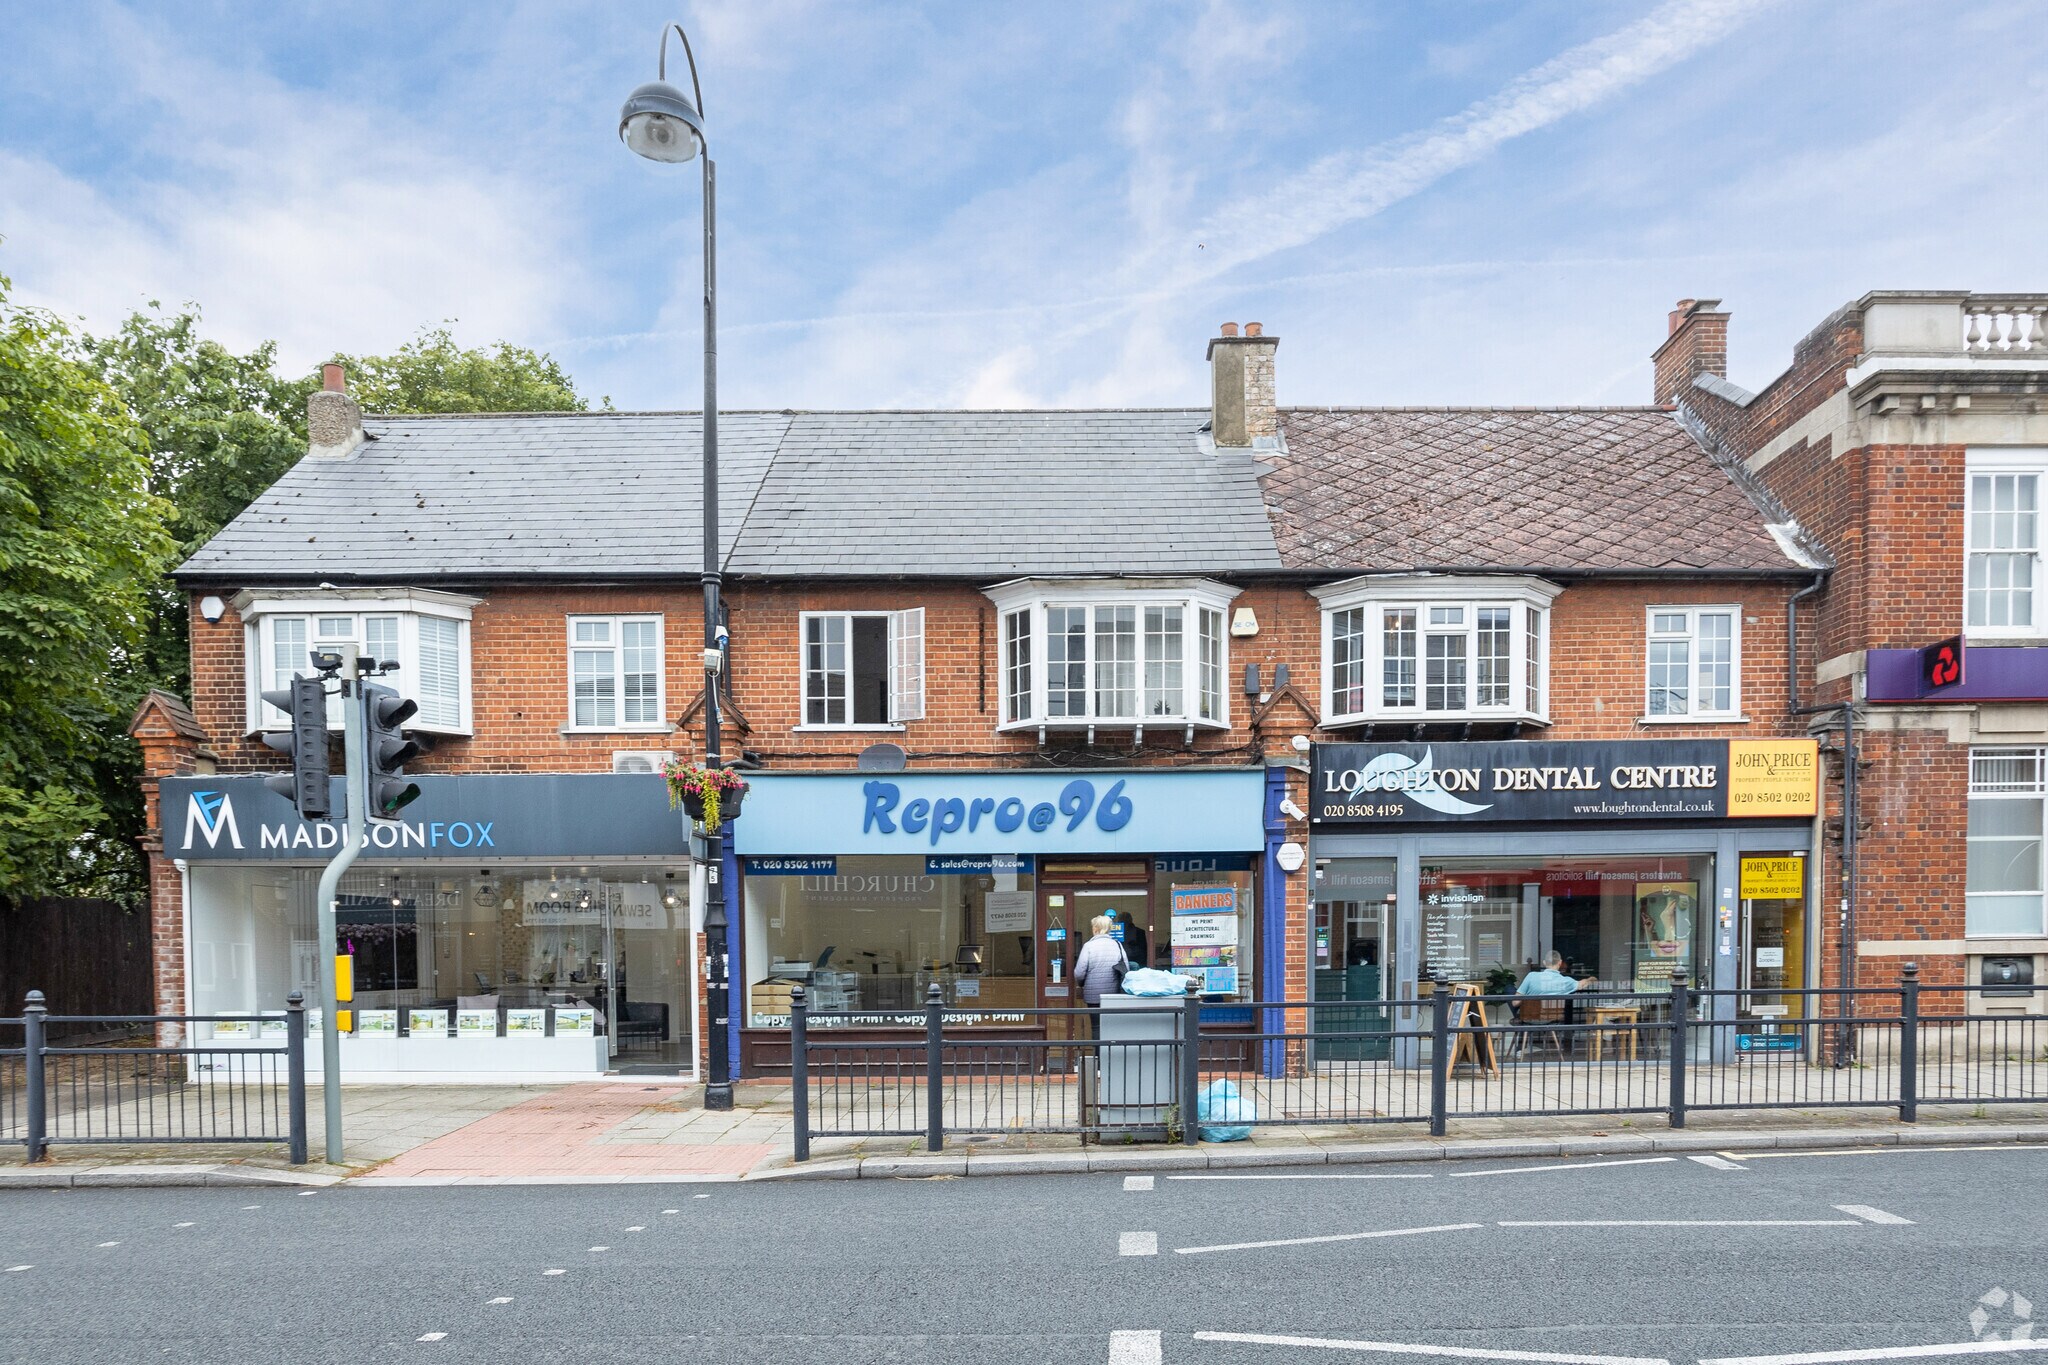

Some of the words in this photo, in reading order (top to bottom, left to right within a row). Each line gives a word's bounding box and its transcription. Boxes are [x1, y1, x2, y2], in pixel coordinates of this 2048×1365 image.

[1736, 753, 1770, 767] JOHN
[1774, 753, 1811, 766] PRICE
[1324, 768, 1482, 793] LOUGHTON
[1492, 767, 1601, 791] DENTAL
[1610, 765, 1717, 789] CENTRE
[1734, 792, 1753, 803] 020
[1757, 792, 1782, 802] 8502
[1785, 792, 1811, 802] 0202
[863, 779, 1133, 846] Repro@96
[1324, 805, 1345, 817] 020
[1347, 804, 1374, 817] 8508
[1376, 804, 1404, 816] 4195
[1573, 801, 1715, 815] www.loughtondental.co.uk
[763, 860, 782, 869] 020
[784, 860, 808, 869] 8502
[811, 860, 833, 869] 1177
[941, 859, 1025, 870] sales@repro96.com
[1745, 861, 1768, 872] JOHN
[1771, 861, 1798, 871] PRICE
[1176, 892, 1233, 910] BANNERS
[1441, 894, 1484, 903] invisalign
[754, 1011, 788, 1027] Copy
[806, 1015, 841, 1027] esign
